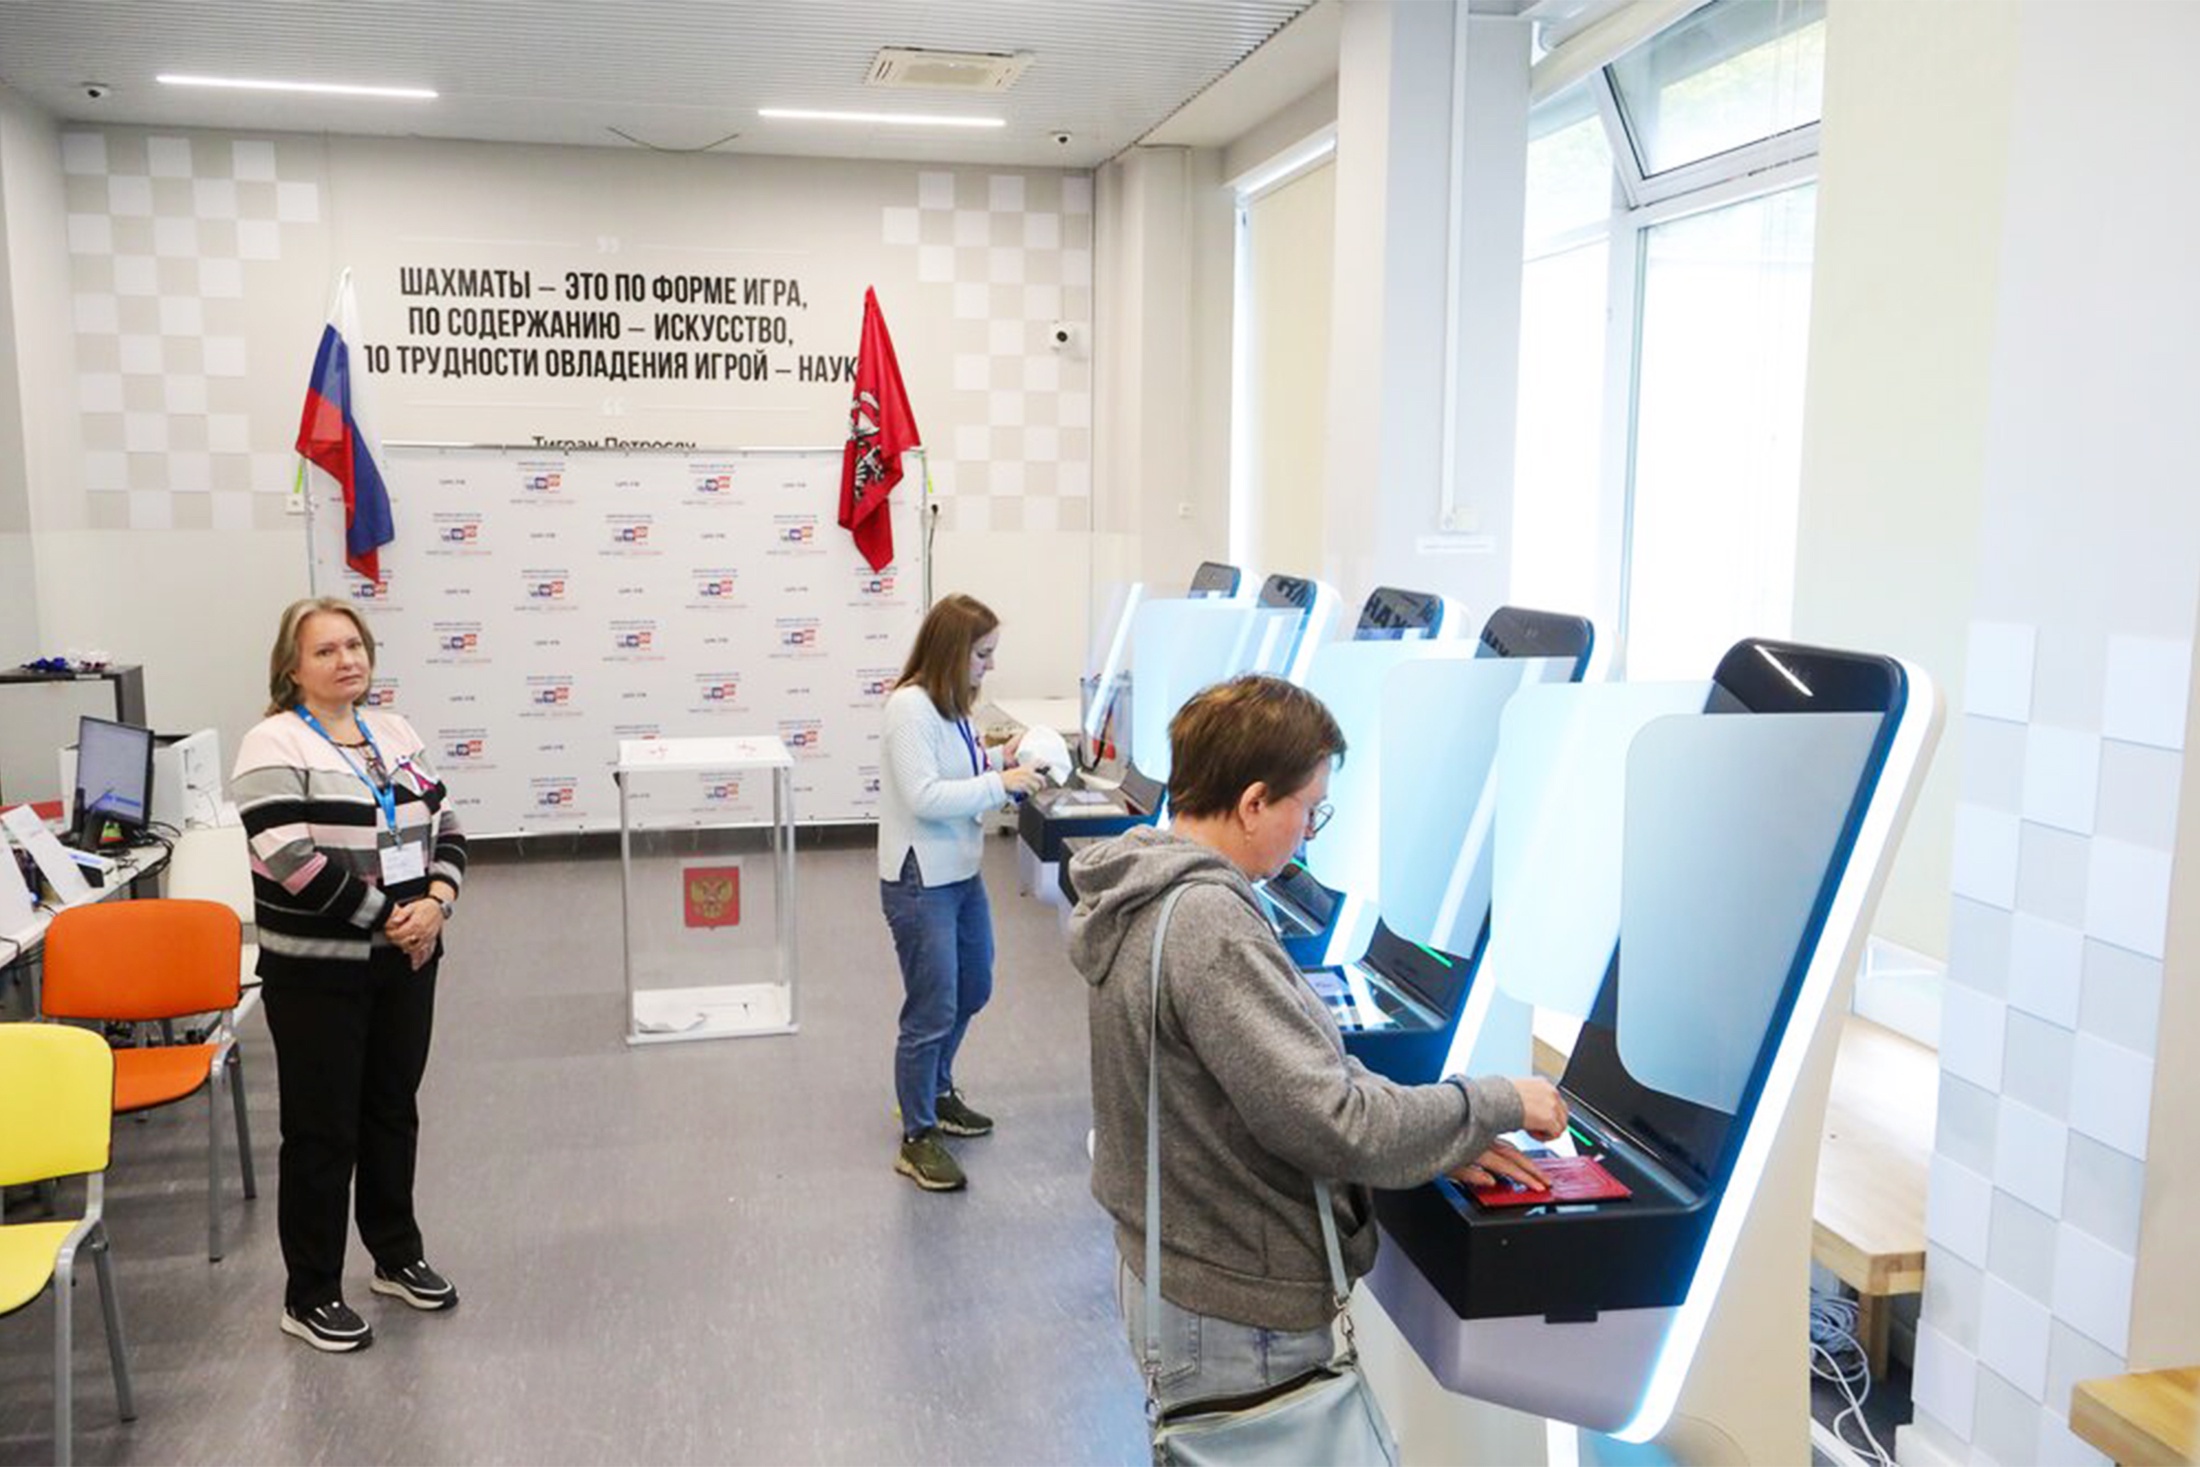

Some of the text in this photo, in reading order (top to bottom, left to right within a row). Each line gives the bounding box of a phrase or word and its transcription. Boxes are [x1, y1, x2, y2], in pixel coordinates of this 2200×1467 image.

[400, 267, 531, 299] ШАХМАТЫ
[564, 271, 609, 302] ЭТО
[614, 273, 646, 303] ПО
[652, 274, 737, 305] ФОРМЕ
[743, 277, 808, 309] ИГРА,
[408, 306, 441, 336] ПО
[447, 307, 621, 341] СОДЕРЖАНИЮ
[654, 312, 794, 347] ИСКУССТВО,
[396, 345, 539, 379] ТРУДНОСТИ
[545, 348, 688, 382] ОВЛАДЕНИЯ
[694, 349, 768, 381] ИГРОЙ
